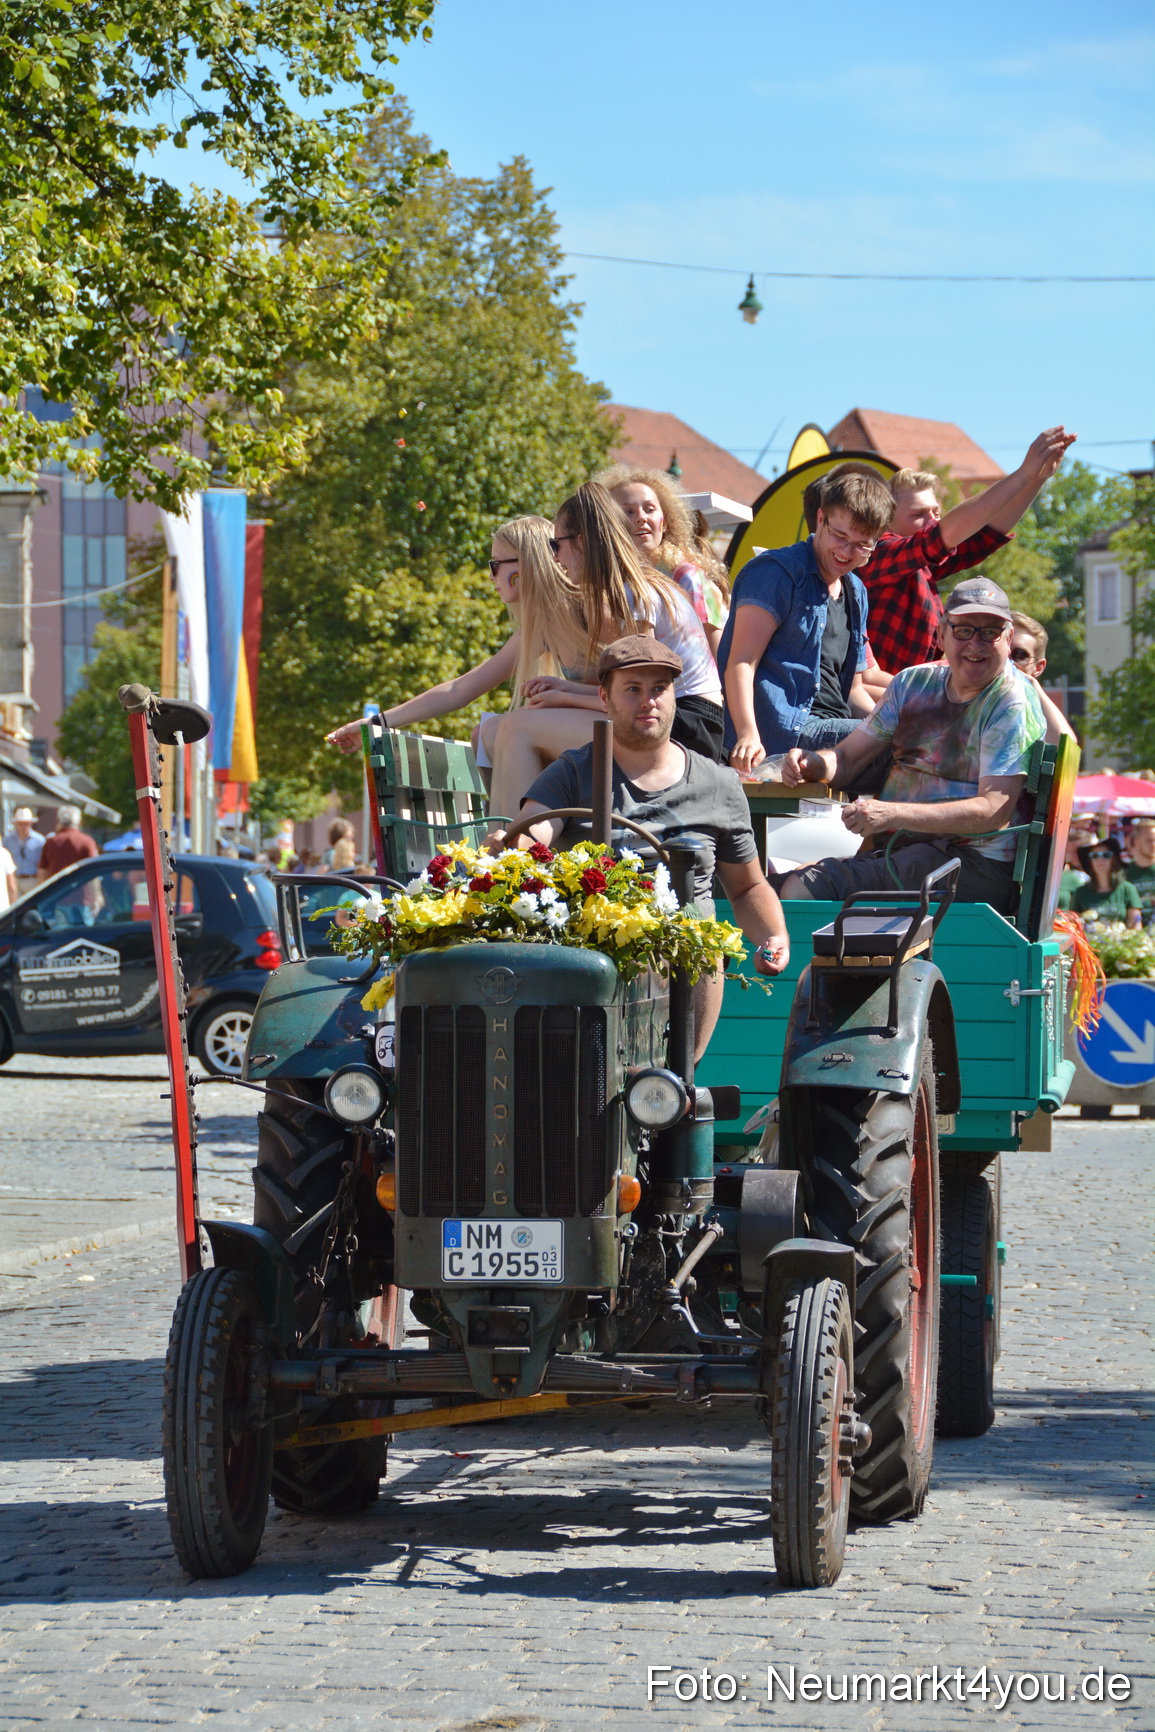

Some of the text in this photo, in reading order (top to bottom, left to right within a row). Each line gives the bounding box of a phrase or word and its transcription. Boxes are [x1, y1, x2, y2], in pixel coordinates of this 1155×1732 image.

[107, 985, 120, 996] 77
[492, 1017, 508, 1205] HANOMAG
[449, 1237, 456, 1246] D
[467, 1224, 502, 1249] NM
[542, 1251, 557, 1262] 03
[449, 1252, 539, 1277] C 1955
[543, 1267, 557, 1278] 10
